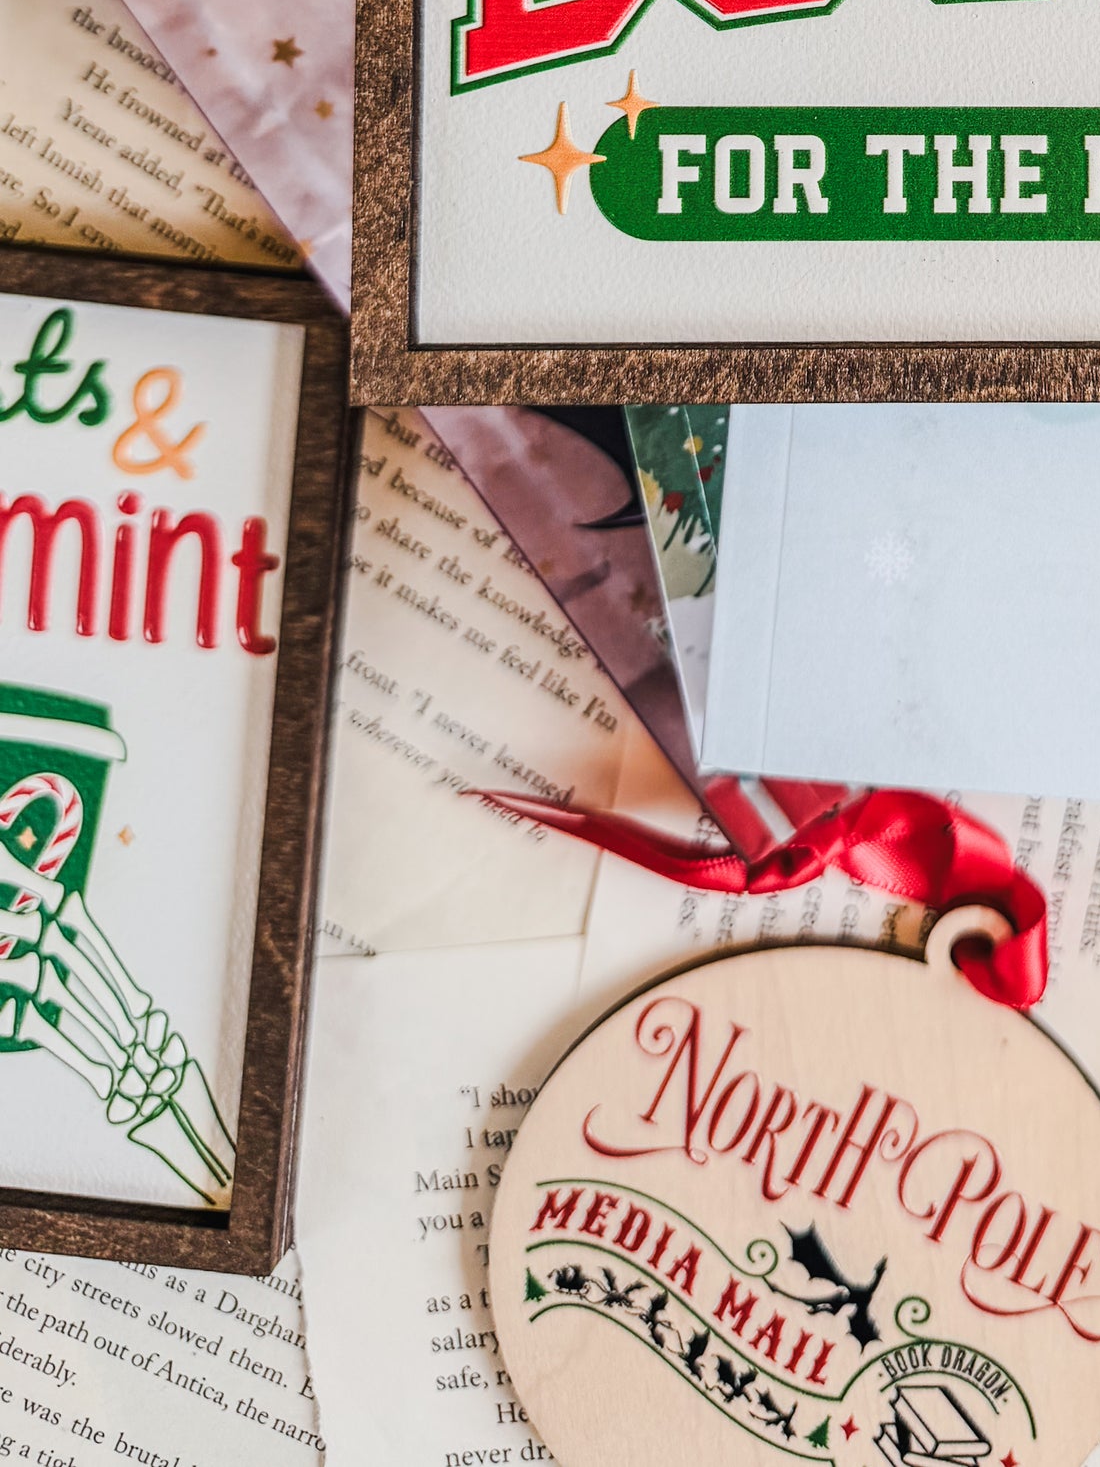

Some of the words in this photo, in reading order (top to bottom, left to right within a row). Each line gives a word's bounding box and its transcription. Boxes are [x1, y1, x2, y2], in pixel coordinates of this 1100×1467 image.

[116, 86, 206, 152] frowned
[656, 133, 829, 216] FOR
[866, 133, 1050, 216] THE
[107, 186, 151, 222] that
[111, 365, 209, 480] &
[437, 554, 473, 586] the
[464, 625, 497, 654] me
[414, 1168, 479, 1194] Main
[417, 1210, 463, 1242] you
[470, 1209, 484, 1228] a
[166, 1274, 188, 1293] as
[195, 1288, 206, 1303] a
[427, 1294, 451, 1315] as
[459, 1291, 473, 1312] a
[530, 1185, 703, 1298] MEDIA
[712, 1275, 838, 1387] MAIL
[24, 1255, 65, 1289] city
[71, 1274, 141, 1319] streets
[148, 1311, 223, 1358] slowed
[230, 1348, 287, 1389] them.
[5, 1293, 38, 1322] the
[39, 1312, 88, 1345] path
[94, 1336, 129, 1362] out
[131, 1350, 160, 1372] of
[154, 1359, 229, 1412] Antica,
[236, 1397, 269, 1426] the
[883, 1341, 933, 1377] BOOK
[939, 1344, 1007, 1399] DRAGON
[436, 1365, 489, 1394] safe,
[23, 1395, 62, 1427] was
[71, 1417, 105, 1446] the
[18, 1443, 30, 1458] a
